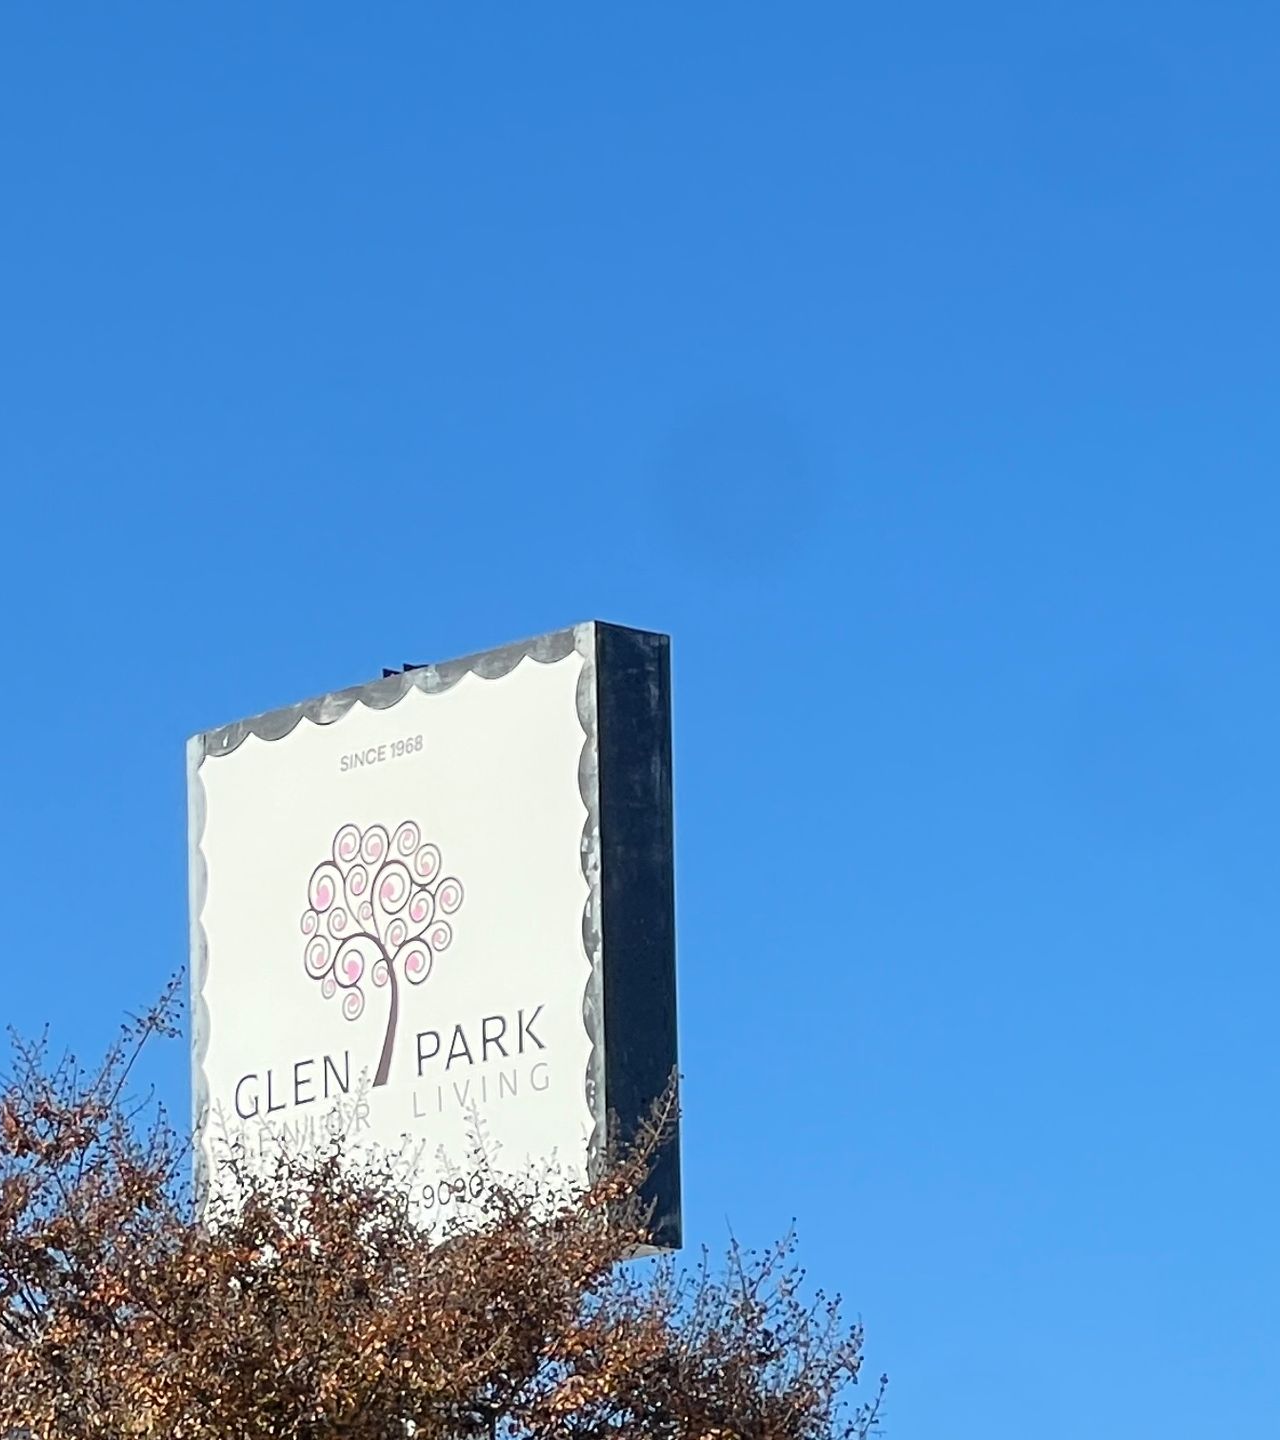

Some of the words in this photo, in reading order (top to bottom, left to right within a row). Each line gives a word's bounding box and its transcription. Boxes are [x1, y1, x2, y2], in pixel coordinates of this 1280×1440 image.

[340, 744, 387, 772] SINCE
[390, 734, 424, 759] 1968
[235, 1050, 349, 1120] GLEN
[416, 1003, 546, 1076] PARK
[412, 1062, 550, 1118] LIVING
